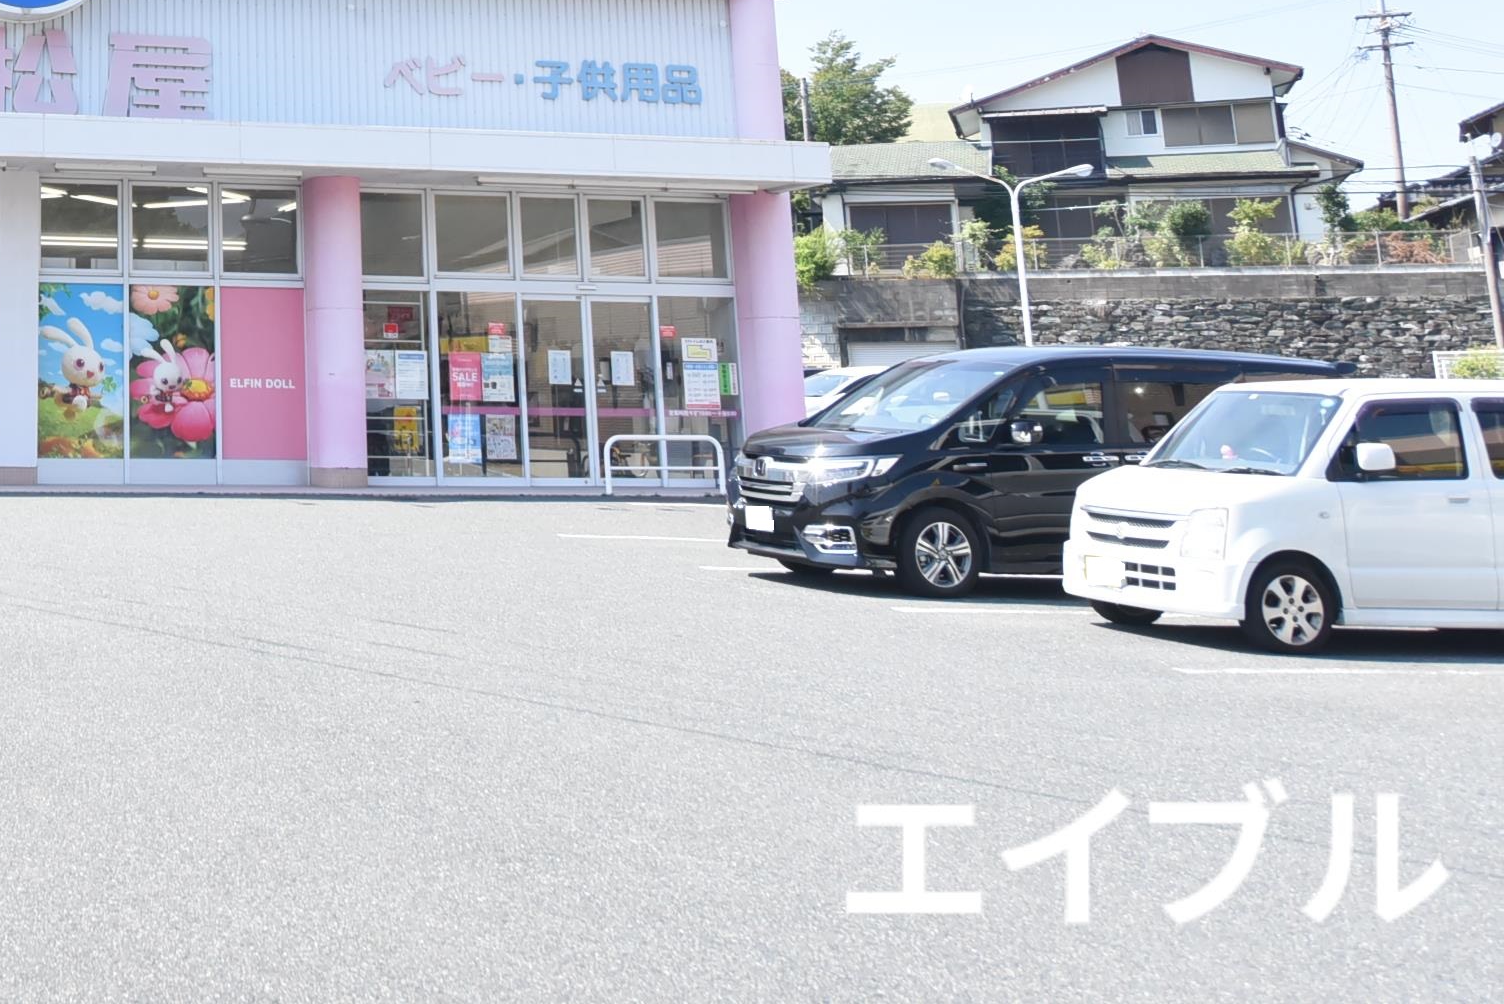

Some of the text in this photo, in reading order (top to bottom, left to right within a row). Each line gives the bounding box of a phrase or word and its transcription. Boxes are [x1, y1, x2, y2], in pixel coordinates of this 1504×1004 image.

[383, 55, 703, 105] ベビー・子供用品
[451, 372, 478, 382] SALE
[229, 378, 296, 389] ELFIN DOLL
